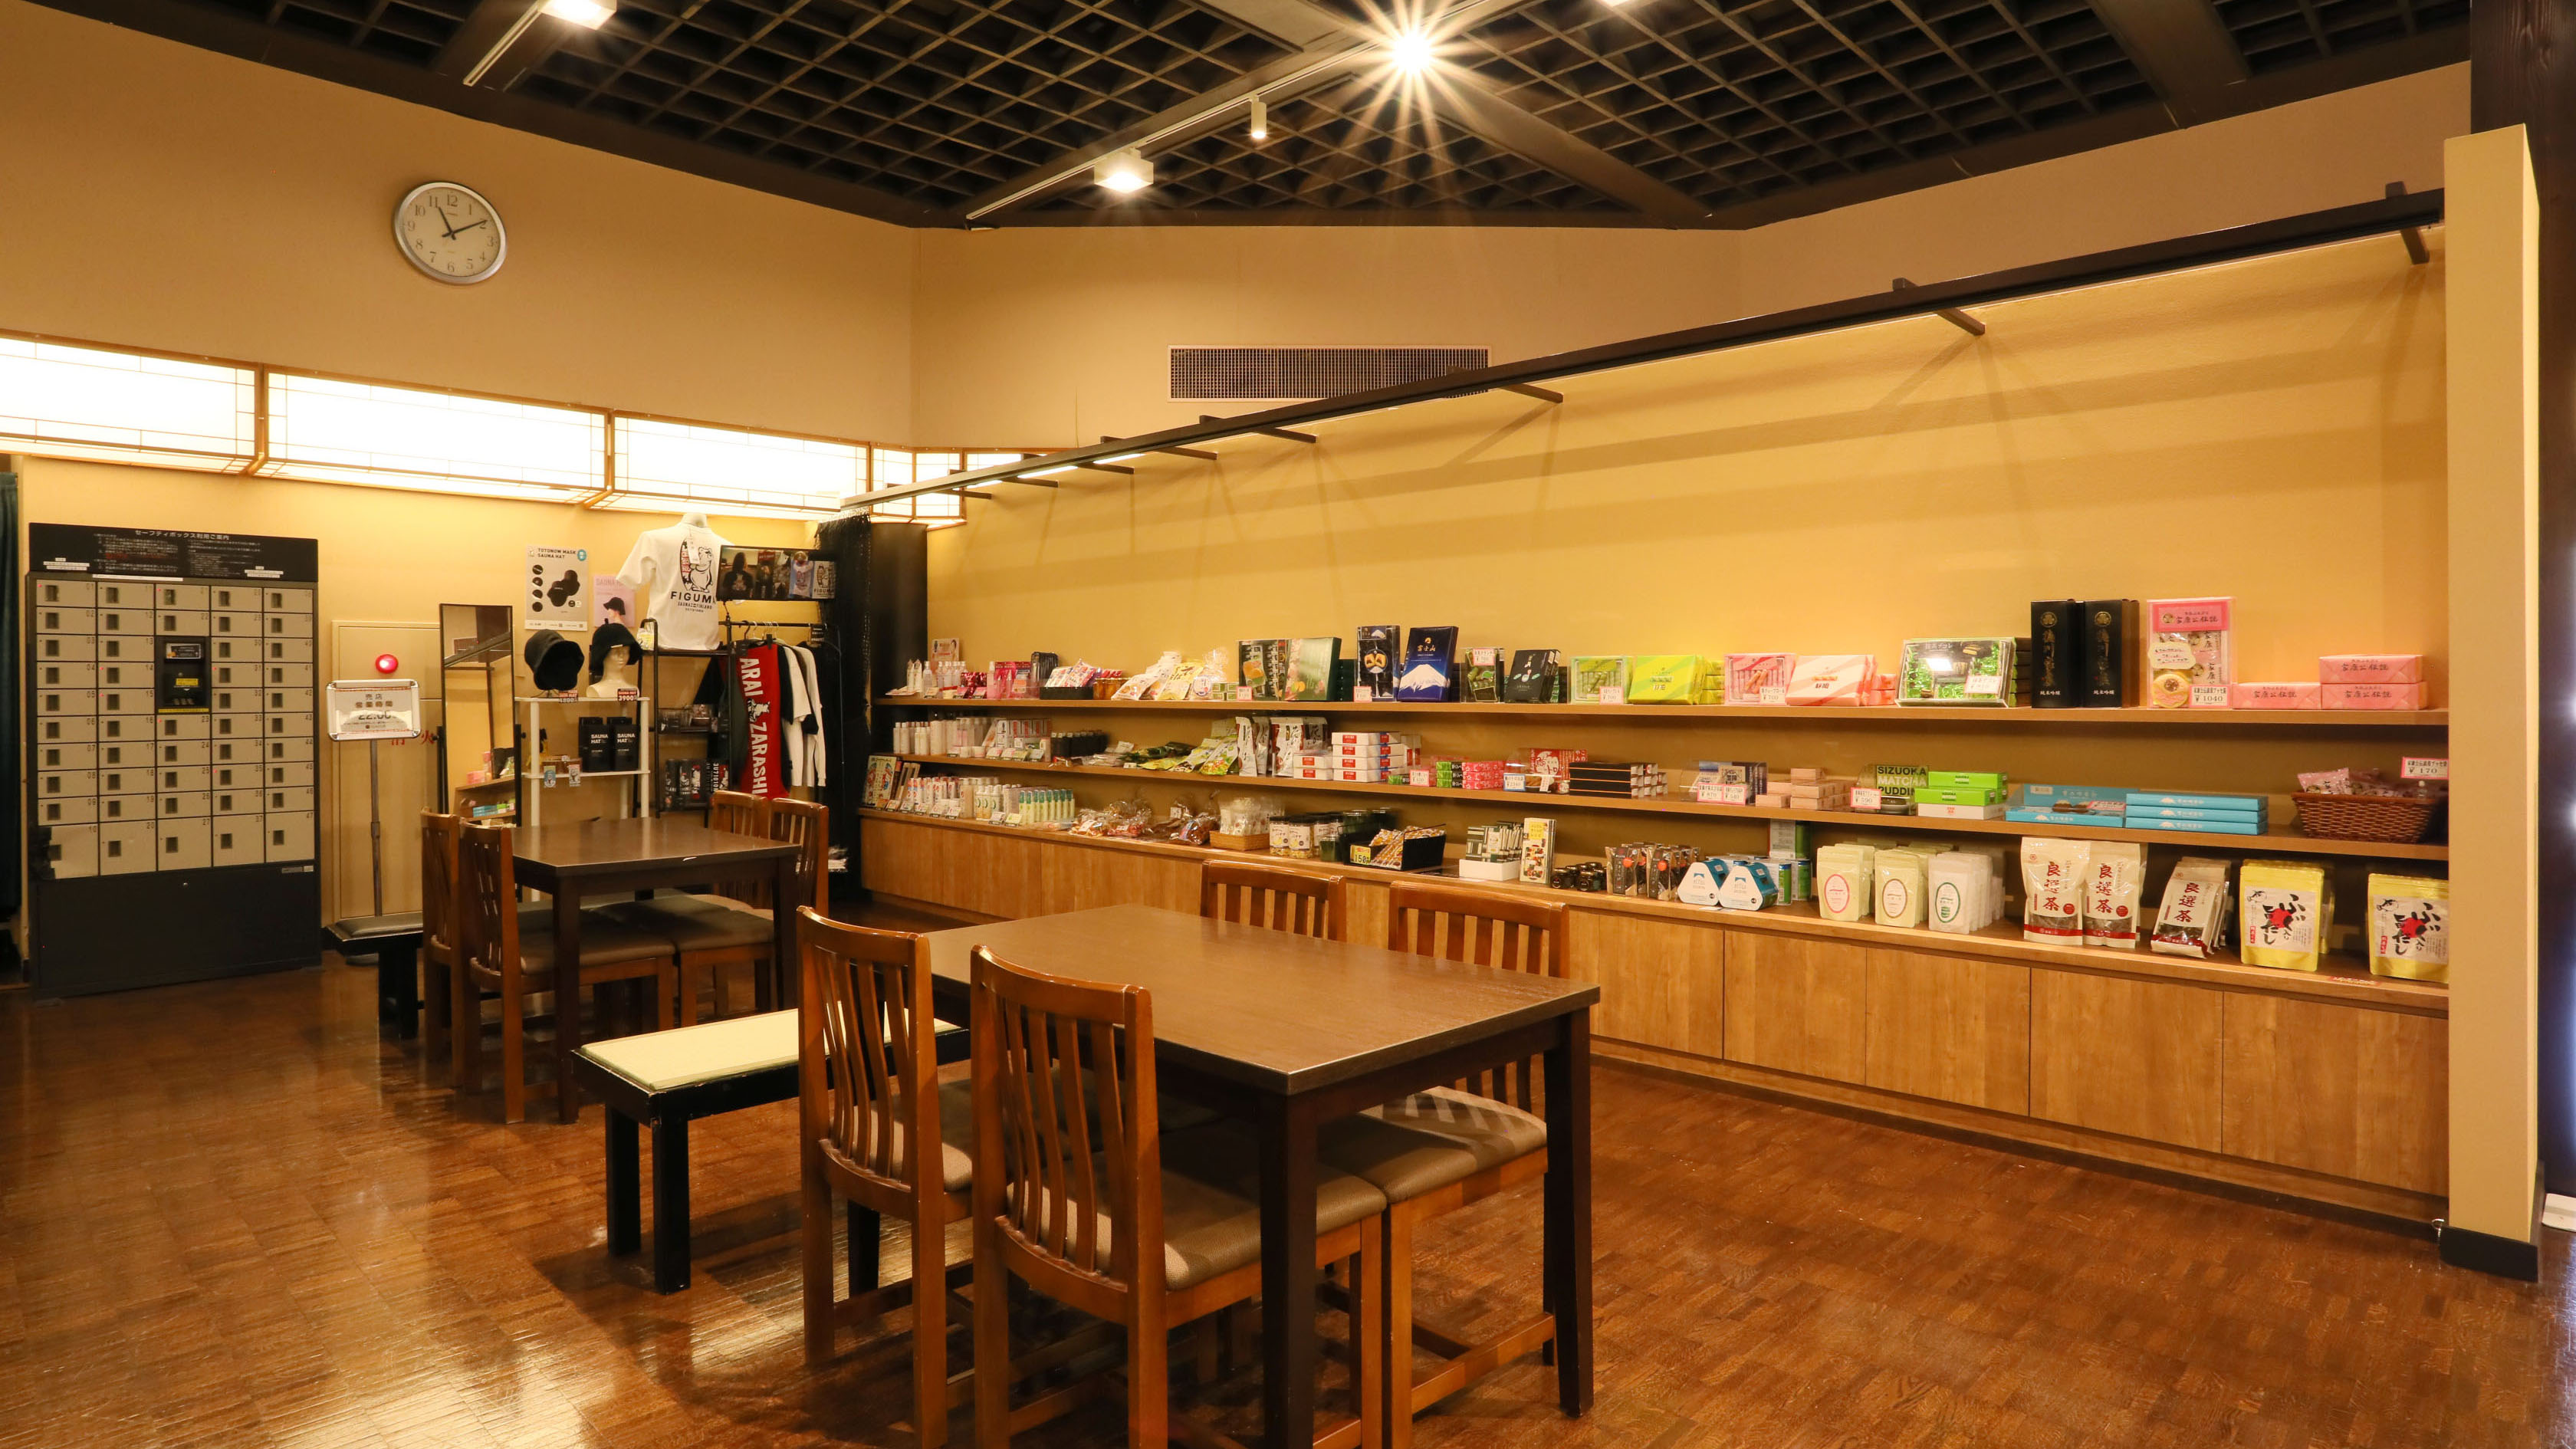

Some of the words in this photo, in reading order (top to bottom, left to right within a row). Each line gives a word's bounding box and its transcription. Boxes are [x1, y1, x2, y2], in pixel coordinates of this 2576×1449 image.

[429, 196, 438, 209] 11
[447, 194, 458, 207] 12
[415, 205, 426, 216] 10
[468, 203, 472, 215] 1
[408, 221, 416, 231] 9
[416, 238, 423, 250] 8
[486, 235, 494, 247] 3
[429, 251, 436, 262] 7
[479, 251, 485, 261] 4
[447, 261, 455, 272] 6
[466, 258, 473, 269] 5
[739, 658, 764, 697] ARAI
[750, 722, 768, 794] ZARASHI
[1878, 766, 1927, 774] SIZUOKA
[1878, 777, 1927, 787] MATCHA
[1878, 787, 1915, 796] PUDDIN
[2042, 861, 2061, 912] 良選茶
[2095, 863, 2113, 914] 良選茶
[2174, 882, 2200, 923] 良選茶
